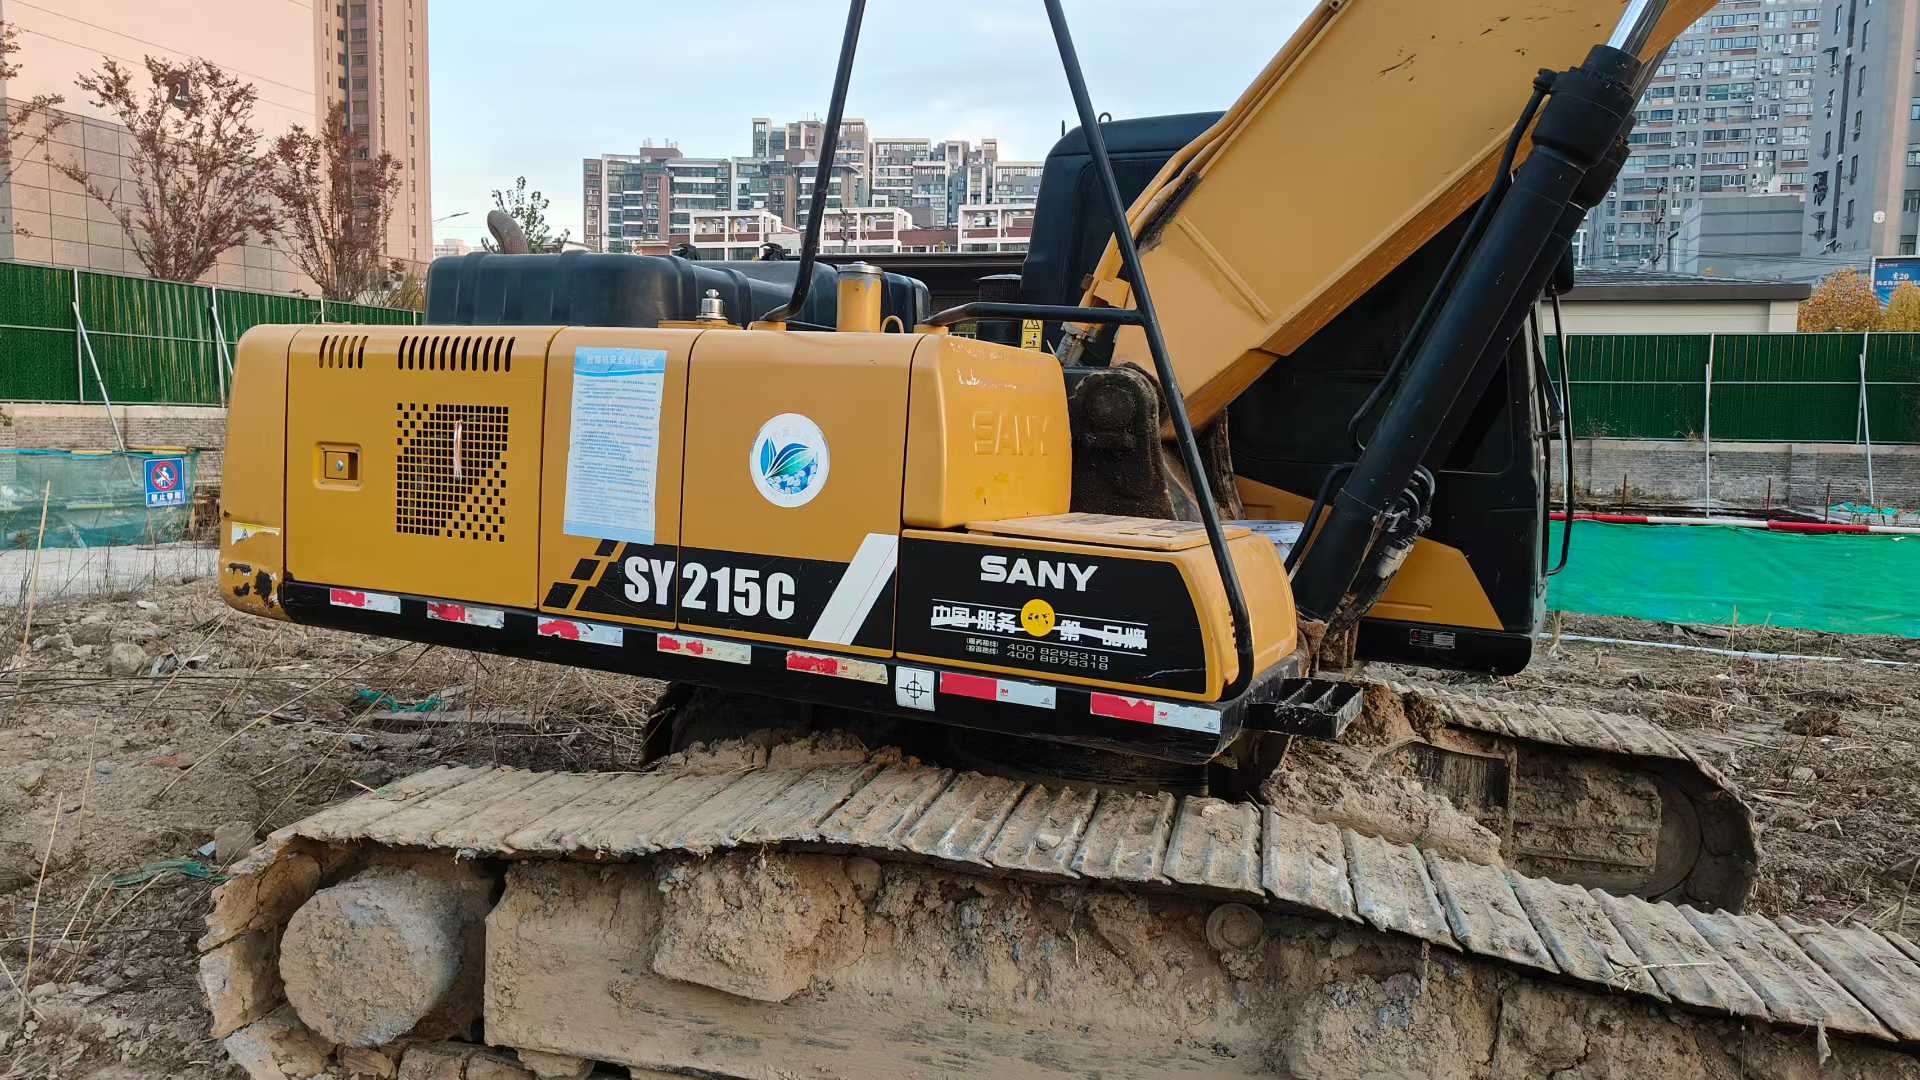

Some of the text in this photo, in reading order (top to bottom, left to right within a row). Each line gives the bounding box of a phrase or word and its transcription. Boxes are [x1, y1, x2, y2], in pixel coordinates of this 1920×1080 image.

[980, 555, 1098, 592] SANY
[1006, 651, 1034, 660] 400
[1039, 655, 1108, 671] 8879318
[1007, 643, 1035, 653] 400
[1040, 647, 1109, 663] 8282318
